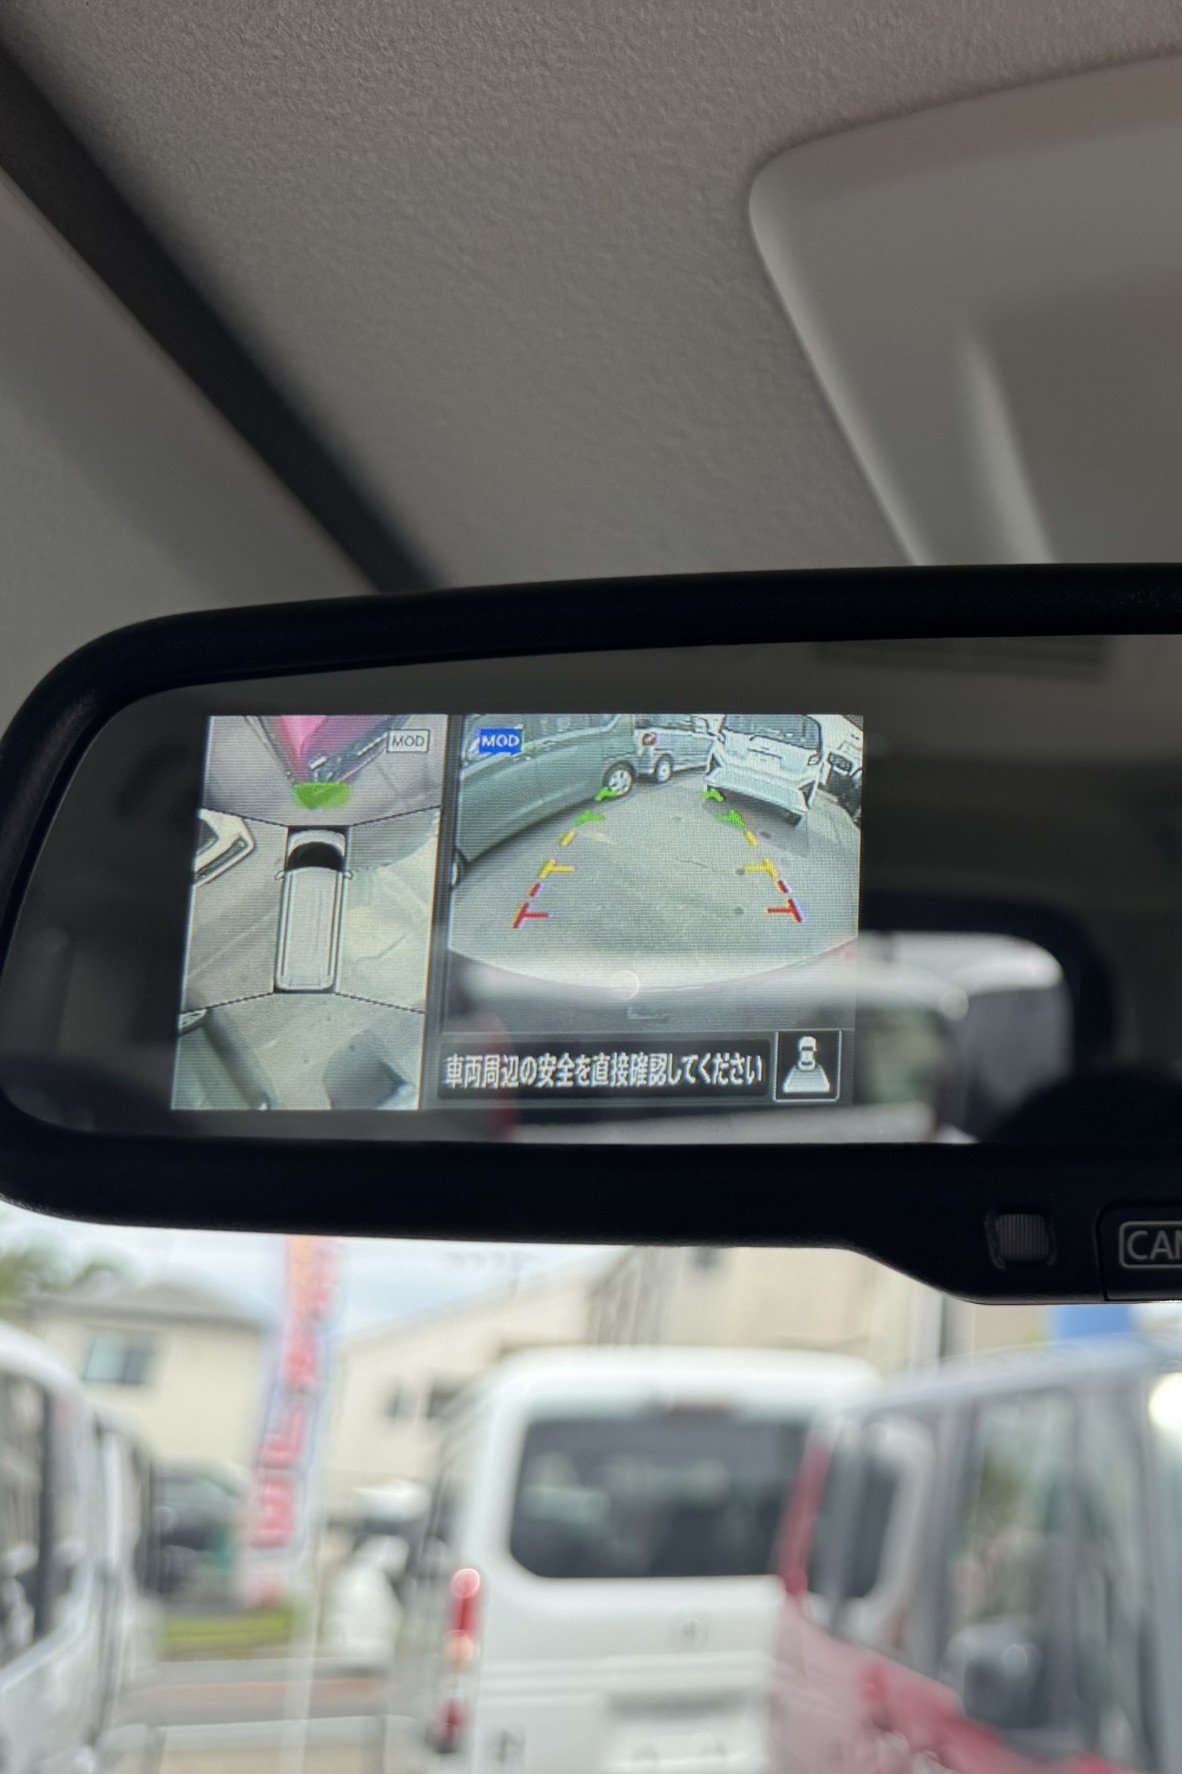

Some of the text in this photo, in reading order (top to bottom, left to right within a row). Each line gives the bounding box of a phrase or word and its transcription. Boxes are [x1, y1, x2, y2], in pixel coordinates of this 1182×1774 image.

[391, 734, 425, 748] MOD
[481, 734, 521, 747] MOD
[446, 1052, 765, 1089] 車両周辺の安全を直接確認してください
